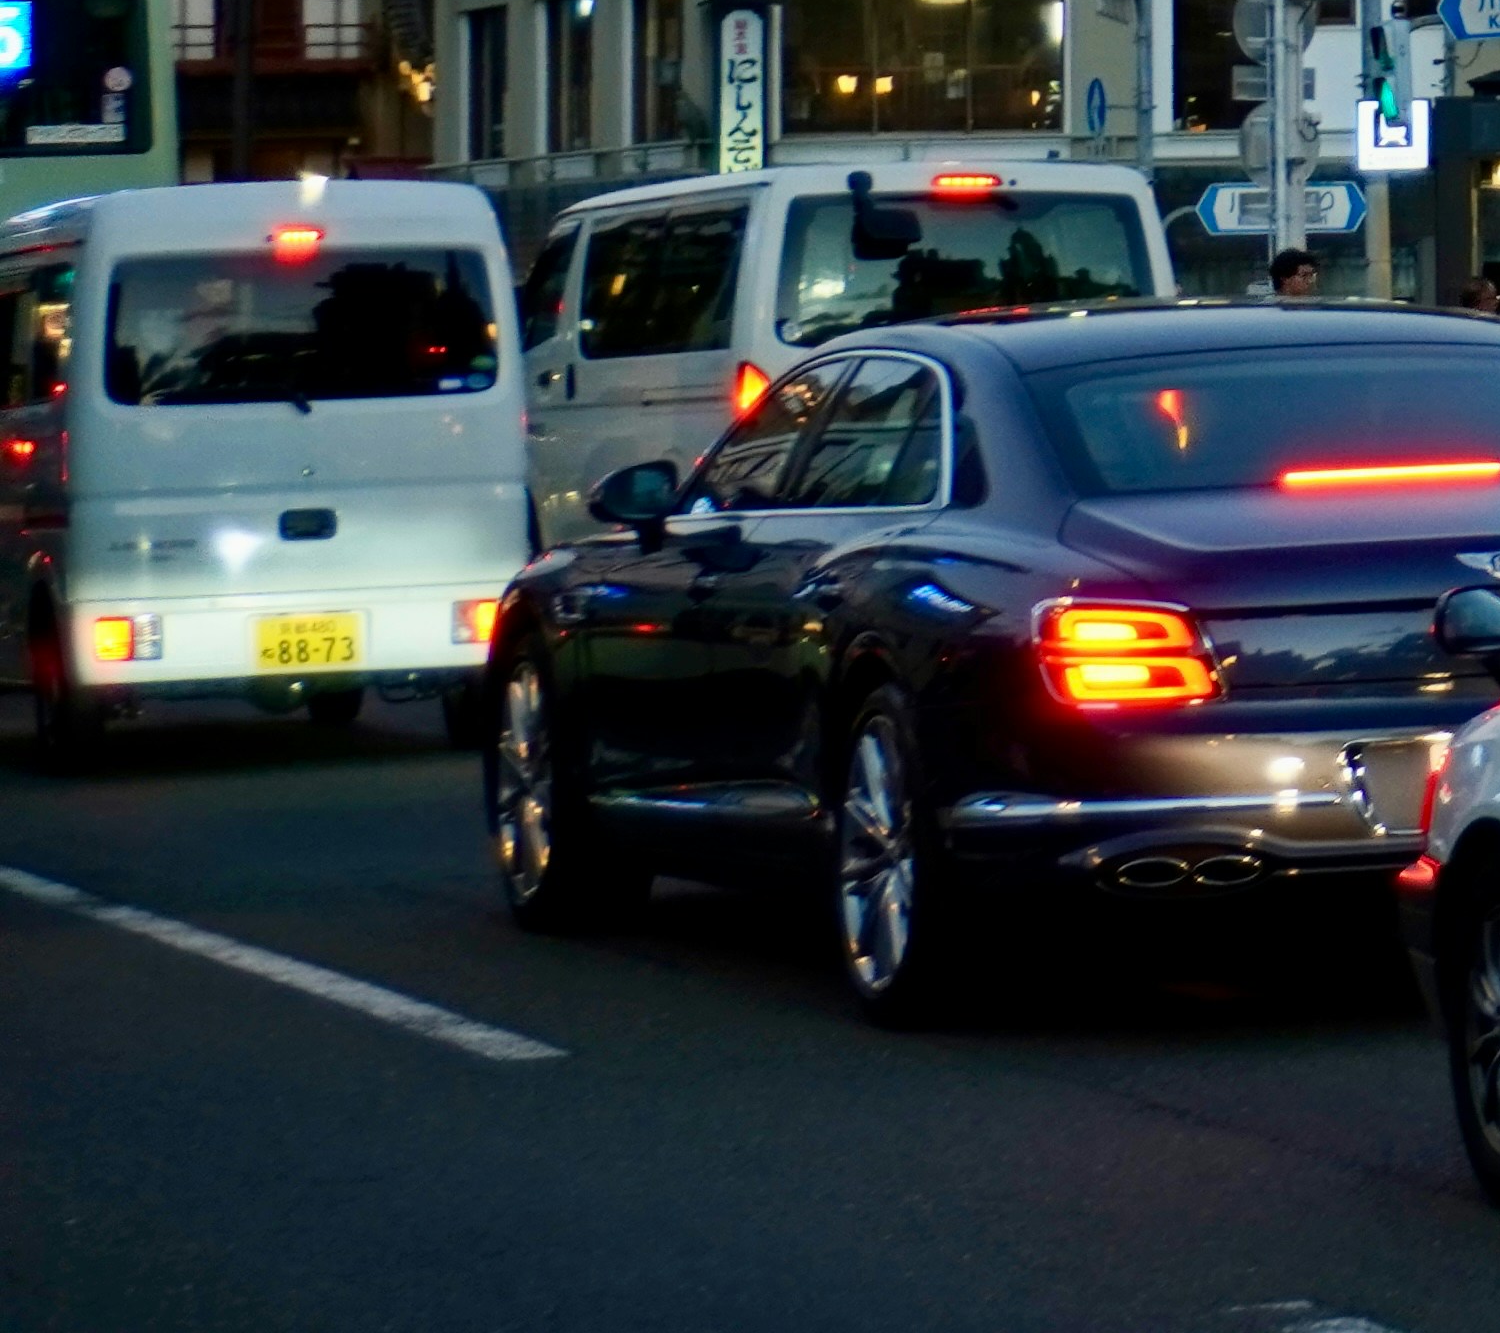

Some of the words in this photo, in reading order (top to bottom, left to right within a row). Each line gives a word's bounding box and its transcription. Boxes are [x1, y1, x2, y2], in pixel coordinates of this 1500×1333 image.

[727, 57, 759, 172] にしんそ
[277, 636, 355, 664] 88-73
